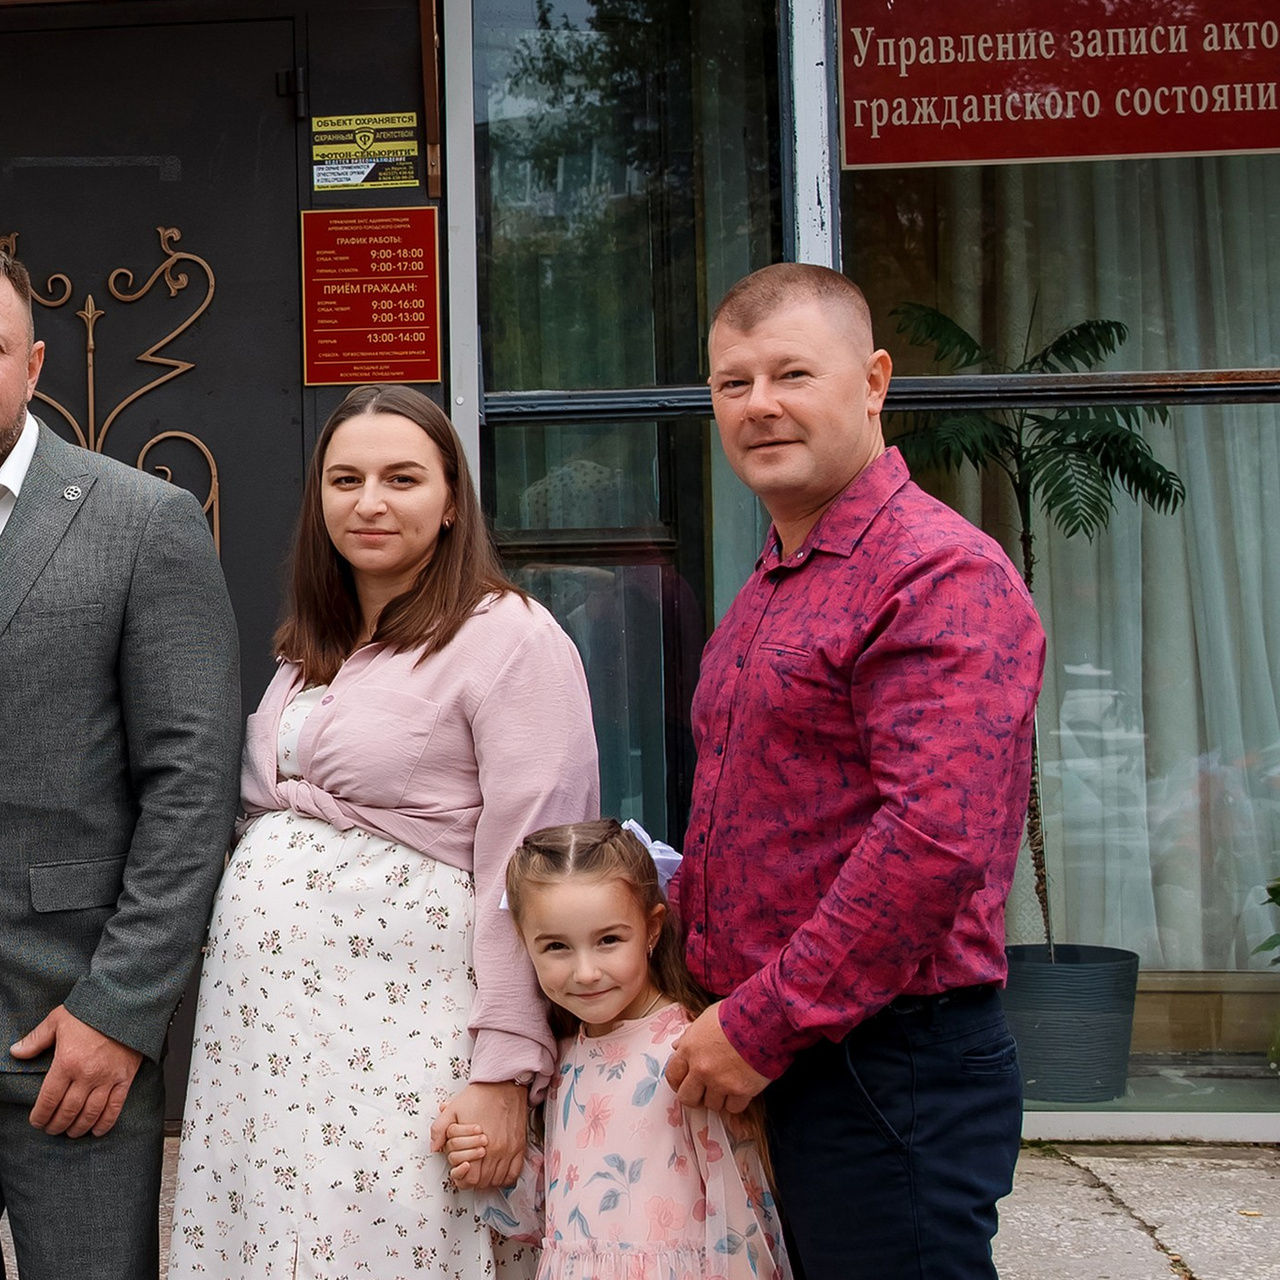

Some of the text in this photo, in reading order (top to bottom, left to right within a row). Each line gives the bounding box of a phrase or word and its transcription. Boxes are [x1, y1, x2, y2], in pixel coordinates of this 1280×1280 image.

[850, 27, 1055, 77] Управление
[1070, 24, 1188, 58] записи
[853, 88, 1100, 139] гражданского
[317, 115, 414, 127] ОБЪЕКТ ОХРАНЯЕТСЯ
[314, 130, 414, 142] ОХРАННЫМ АГЕНТСТВОМ
[336, 236, 402, 245] ГРАФИК РАБОТЫ:
[370, 248, 424, 259] 9:00-18:00
[370, 261, 424, 272] 9:00-17:00
[323, 283, 418, 294] ПРИЁМ ГРАЖДАН:
[371, 299, 425, 310] 9:00-16:00
[371, 312, 425, 323] 9:00-13:00
[367, 332, 426, 343] 13:00-14:00
